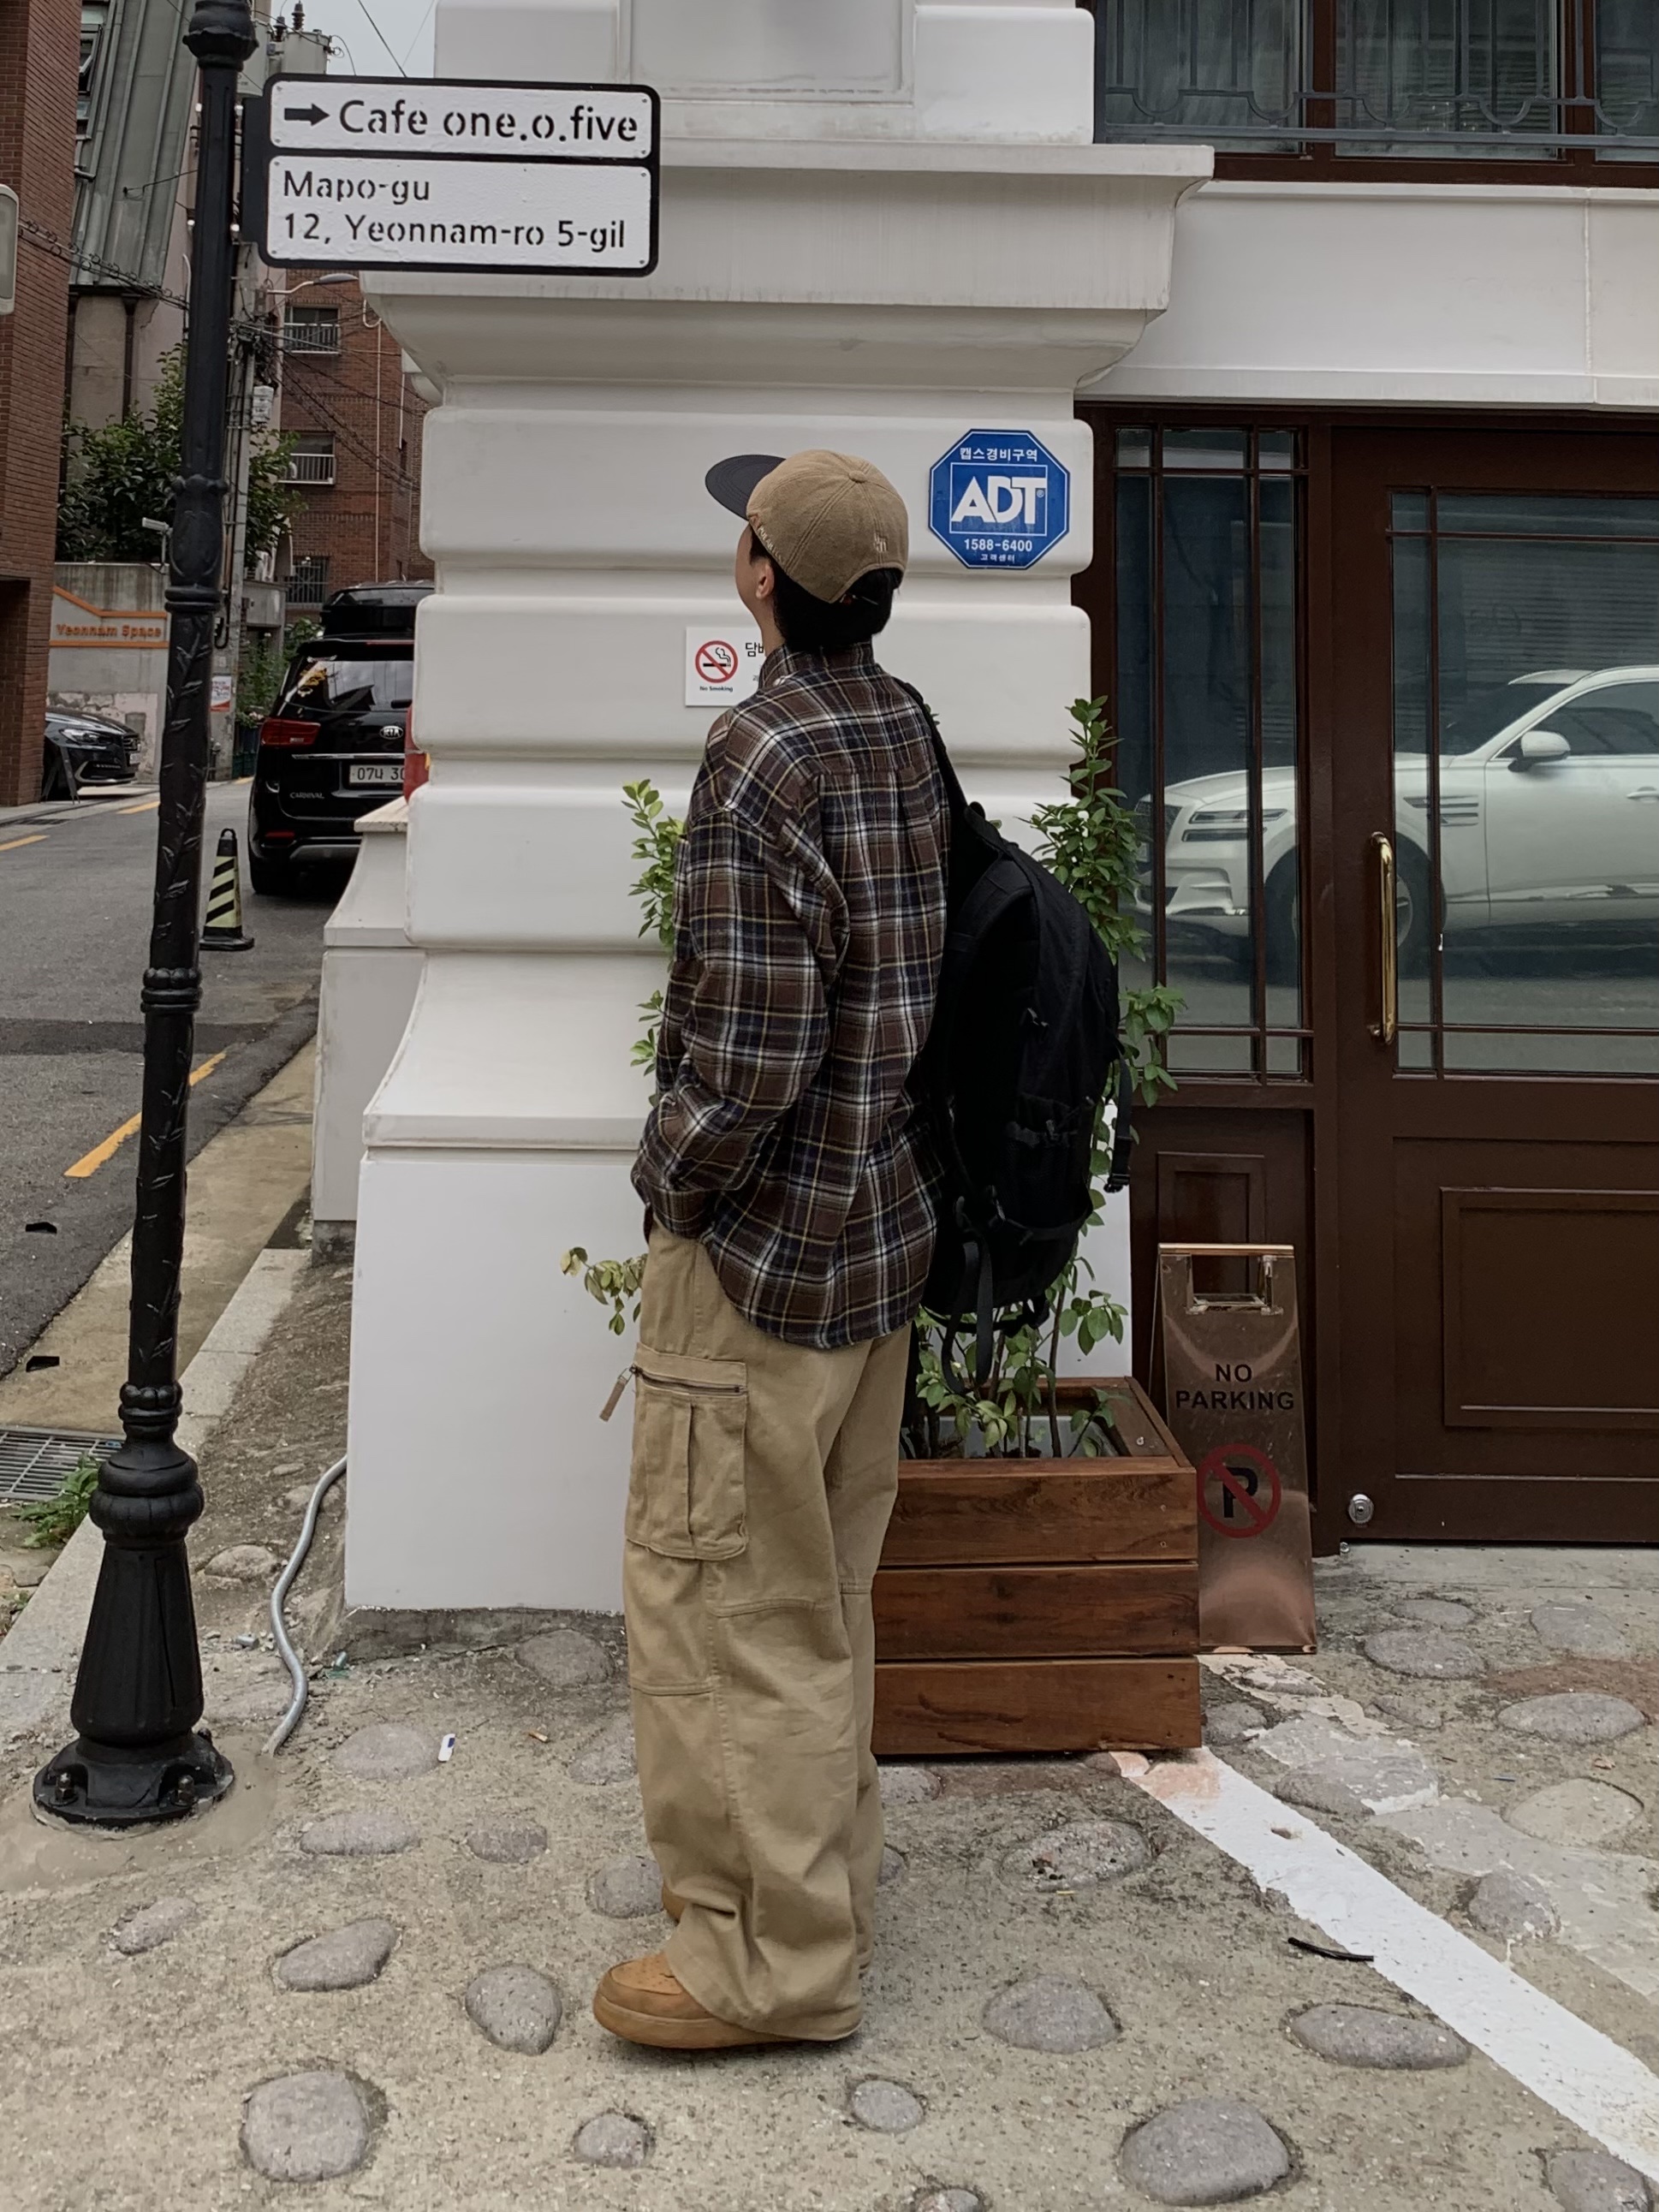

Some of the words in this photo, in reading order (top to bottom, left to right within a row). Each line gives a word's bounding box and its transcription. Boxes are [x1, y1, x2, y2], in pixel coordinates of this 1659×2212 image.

[339, 98, 428, 135] Cafe
[443, 104, 638, 142] one.o.five
[283, 170, 430, 205] Mapo-gu
[284, 213, 331, 245] 12,
[344, 214, 544, 247] Yeonnam-ro
[557, 219, 625, 253] 5-gil
[950, 475, 1047, 525] ADT
[964, 538, 1033, 552] 1588-6400
[980, 553, 1015, 563] 고객센터
[56, 623, 118, 637] Yeonnam
[122, 624, 162, 639] Space
[1215, 1363, 1252, 1383] NO
[1174, 1389, 1294, 1411] PARKING
[1222, 1466, 1258, 1519] P
